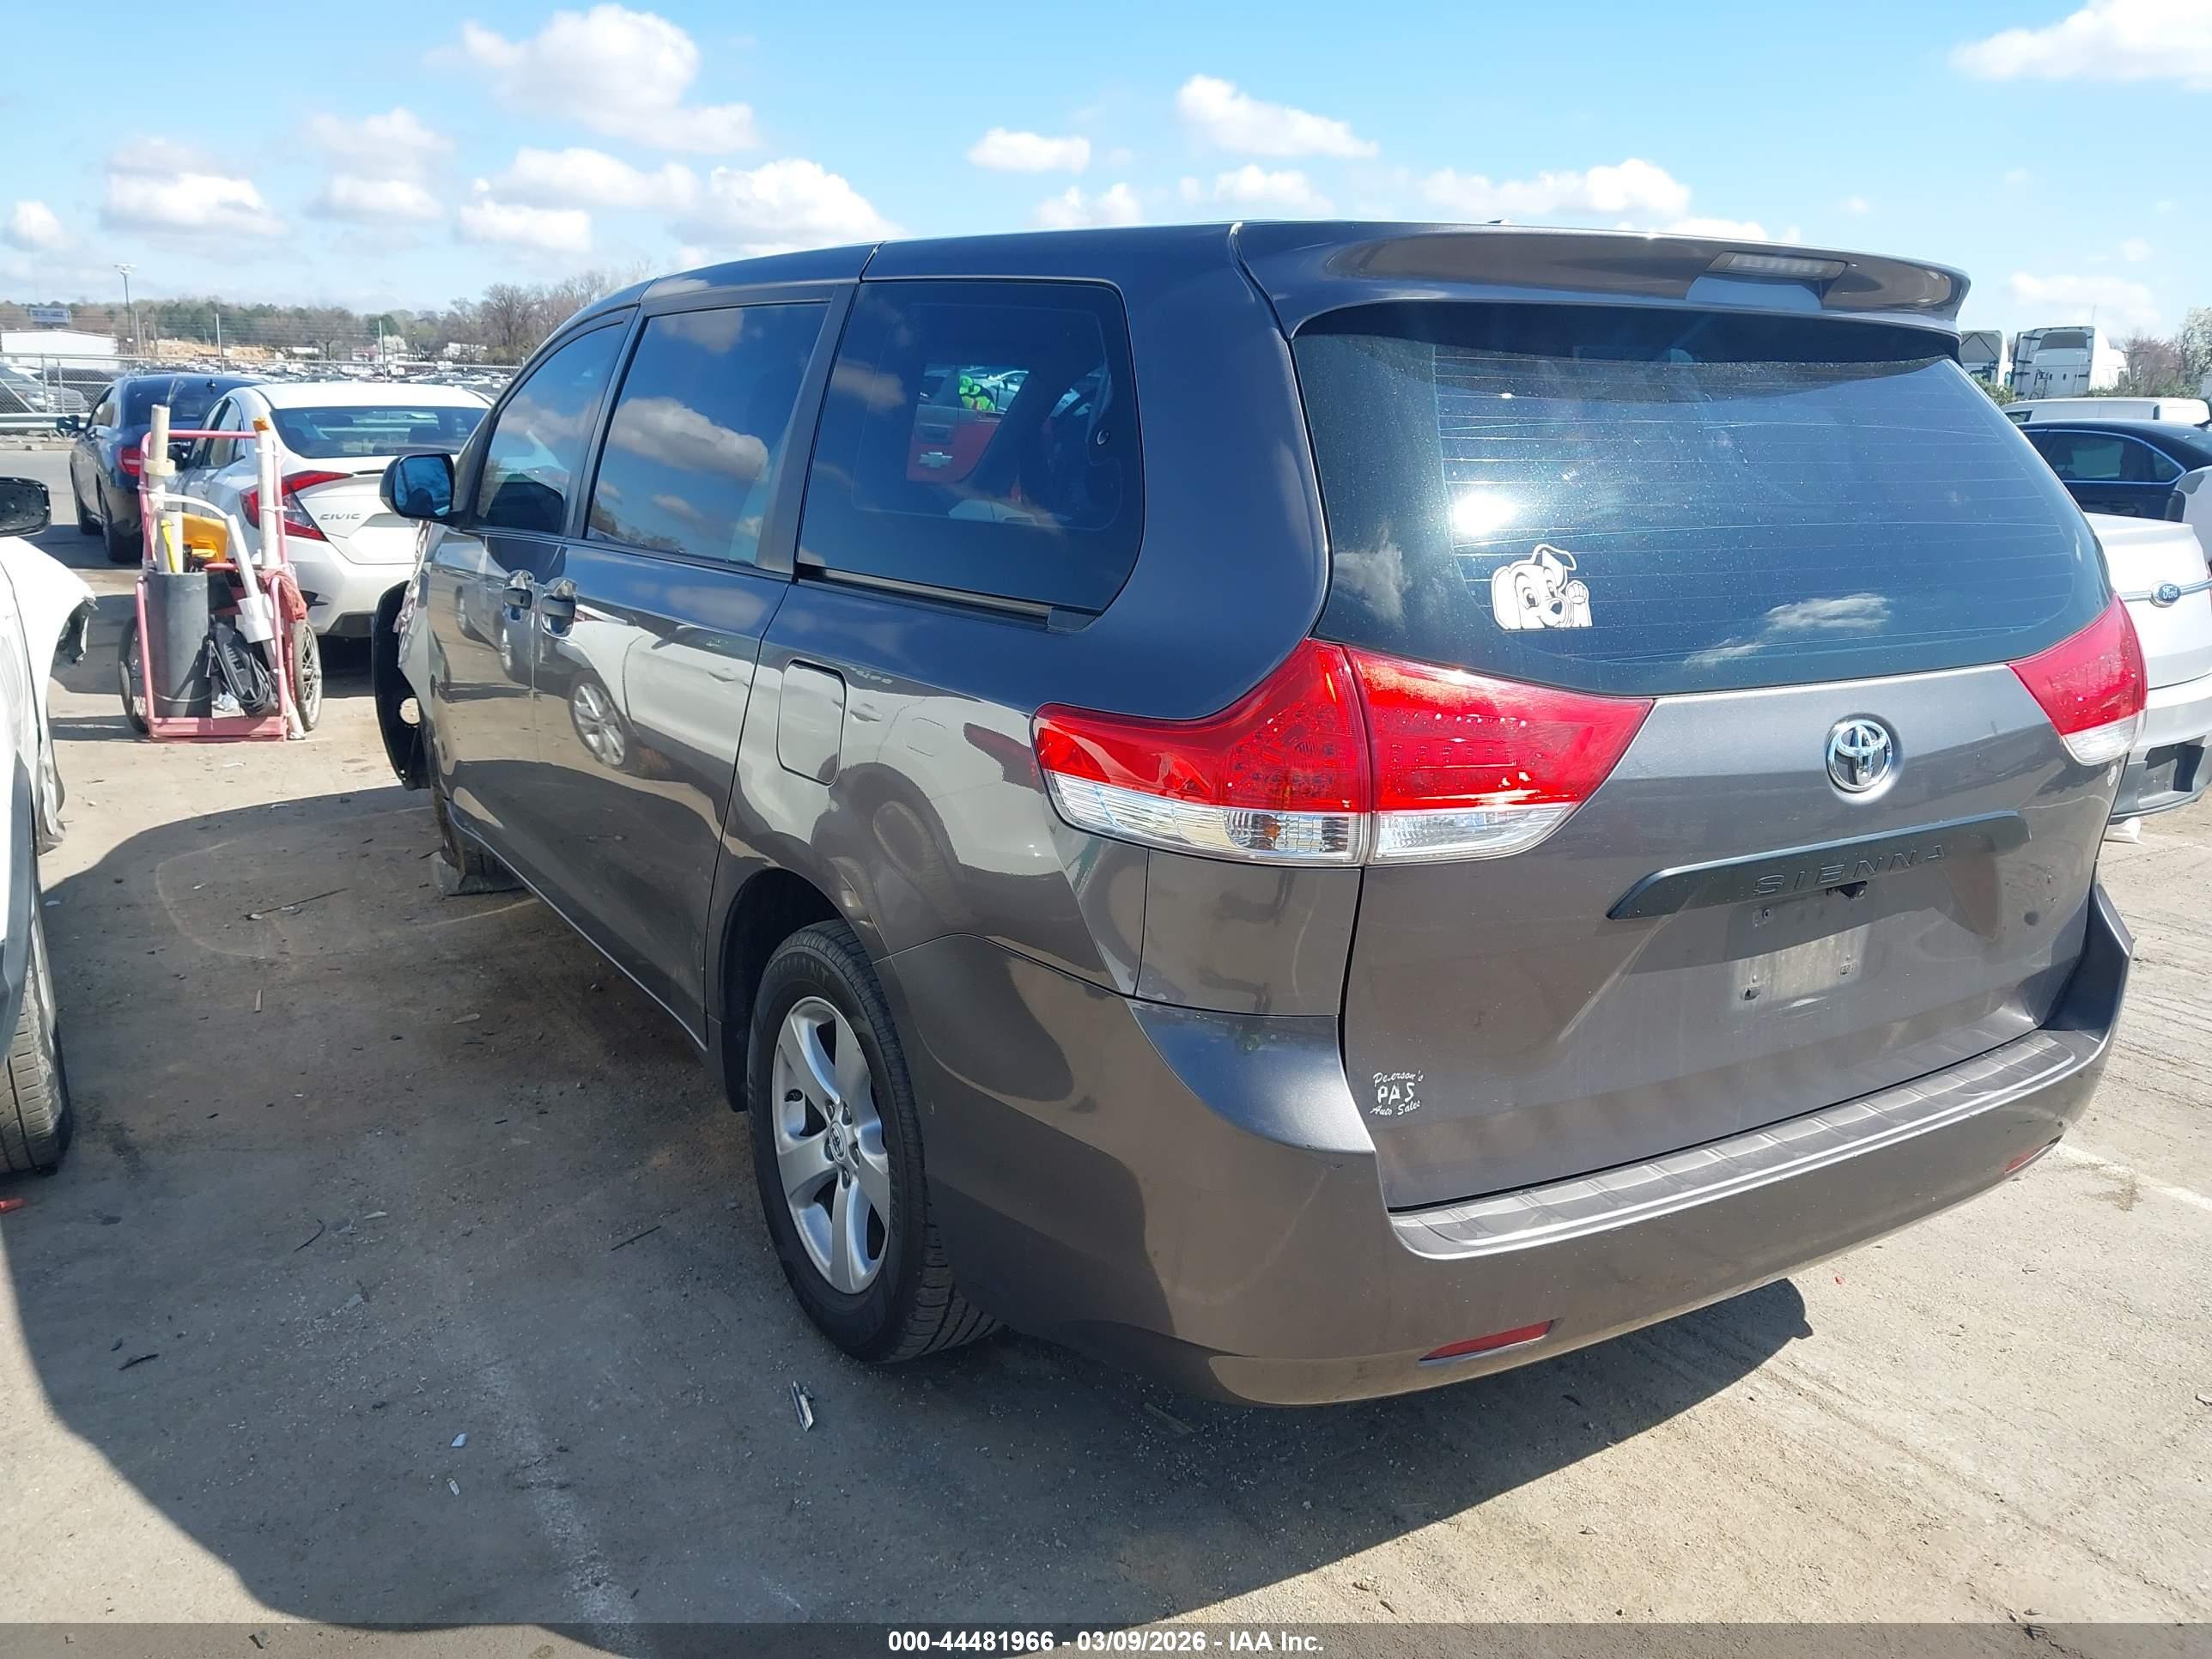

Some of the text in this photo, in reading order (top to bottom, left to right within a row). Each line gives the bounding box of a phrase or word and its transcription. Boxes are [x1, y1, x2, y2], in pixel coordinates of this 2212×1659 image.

[2162, 585, 2179, 599] Ford
[1753, 845, 1945, 896] SIENNA
[1370, 1100, 1421, 1115] Auto Sales
